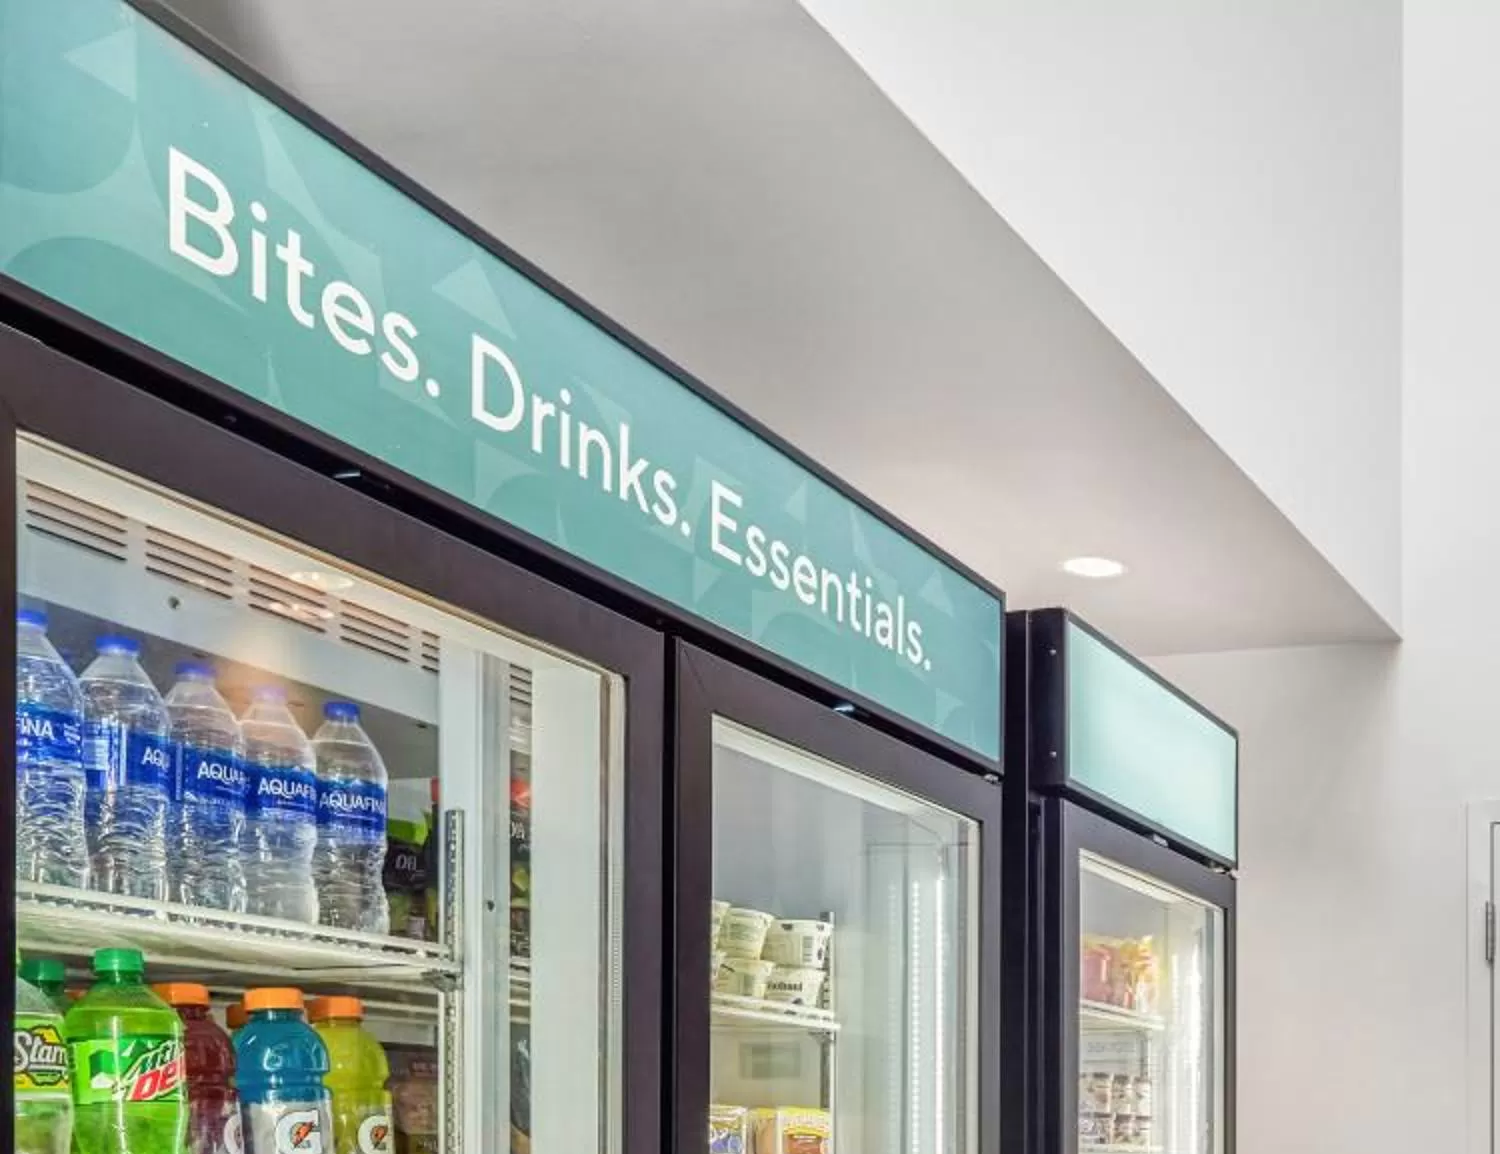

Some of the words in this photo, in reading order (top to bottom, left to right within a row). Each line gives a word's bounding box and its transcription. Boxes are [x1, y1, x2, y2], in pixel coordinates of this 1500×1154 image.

[168, 147, 440, 397] Bites.
[471, 332, 691, 535] Drinks.
[710, 480, 932, 671] Essentials.
